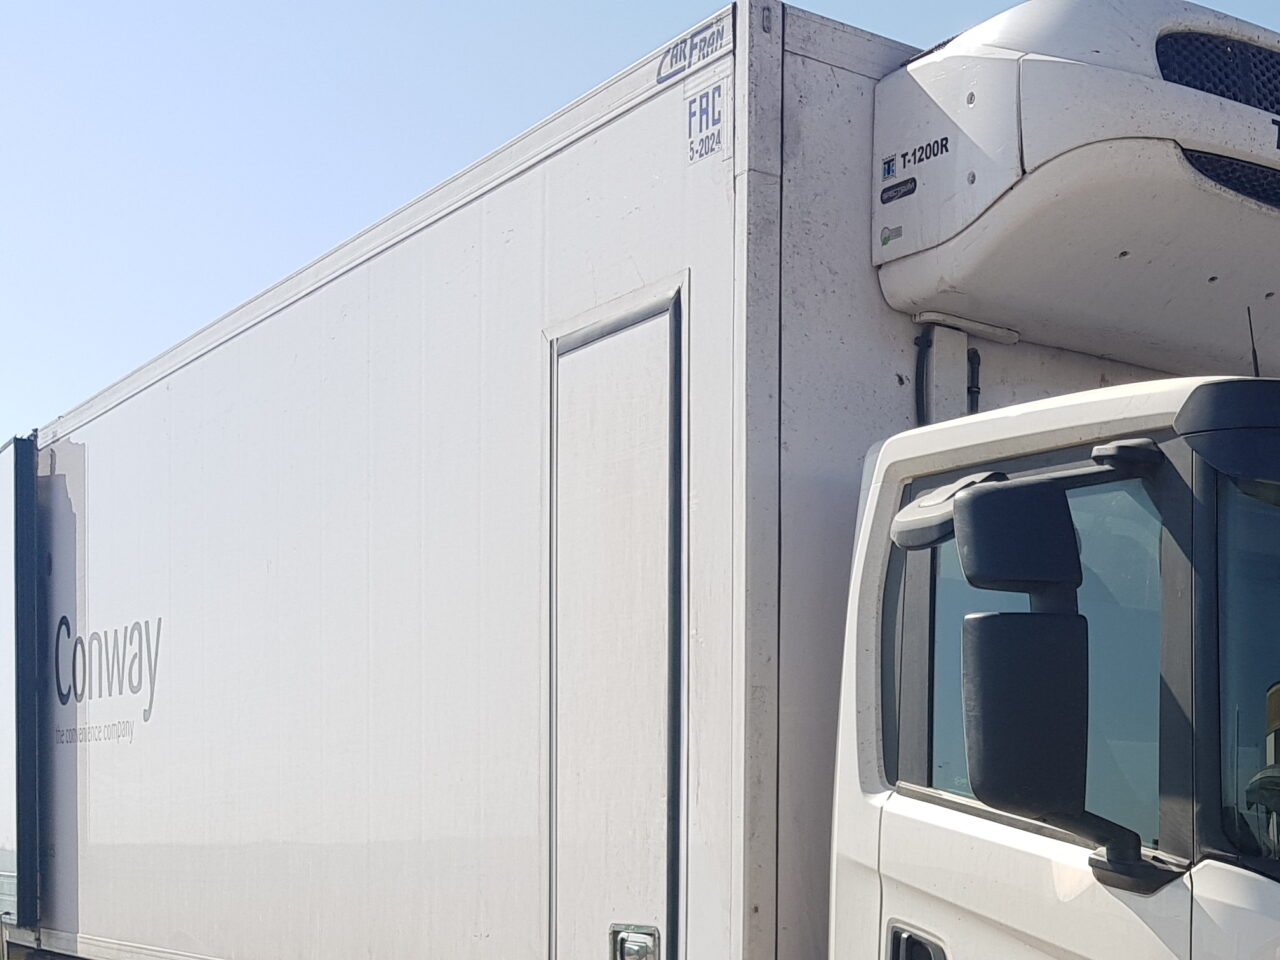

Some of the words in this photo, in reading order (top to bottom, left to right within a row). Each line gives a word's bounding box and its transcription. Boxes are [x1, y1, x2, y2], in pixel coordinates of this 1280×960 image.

[688, 84, 722, 139] FAC
[689, 128, 722, 161] 5-2024
[900, 136, 950, 169] T-1200R
[54, 615, 162, 723] Conway
[103, 720, 134, 744] company
